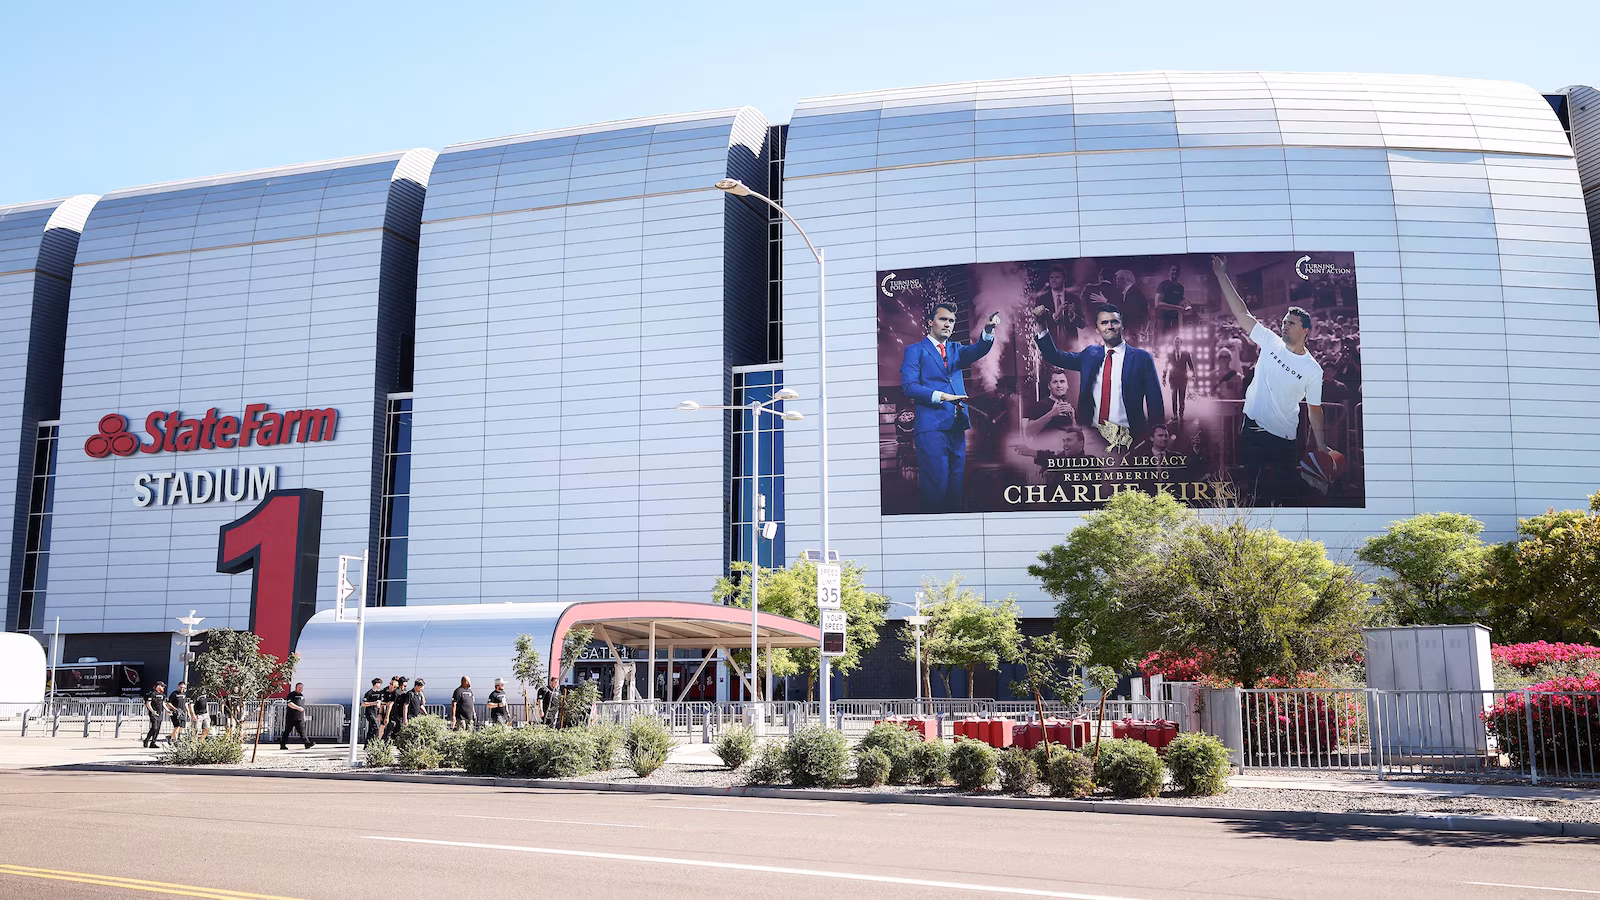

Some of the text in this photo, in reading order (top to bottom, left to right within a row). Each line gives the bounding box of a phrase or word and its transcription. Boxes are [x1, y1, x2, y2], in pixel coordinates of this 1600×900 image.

[890, 279, 920, 287] TURNING
[1047, 455, 1188, 468] BUILDING A LEGACY
[1063, 471, 1170, 482] REMEMBERING
[132, 465, 279, 507] STADIUM
[820, 568, 839, 577] SPEED
[216, 488, 324, 698] 1
[821, 587, 838, 603] 35
[826, 614, 843, 622] YOUR
[825, 622, 844, 631] SPEED
[580, 645, 629, 659] GATE 1
